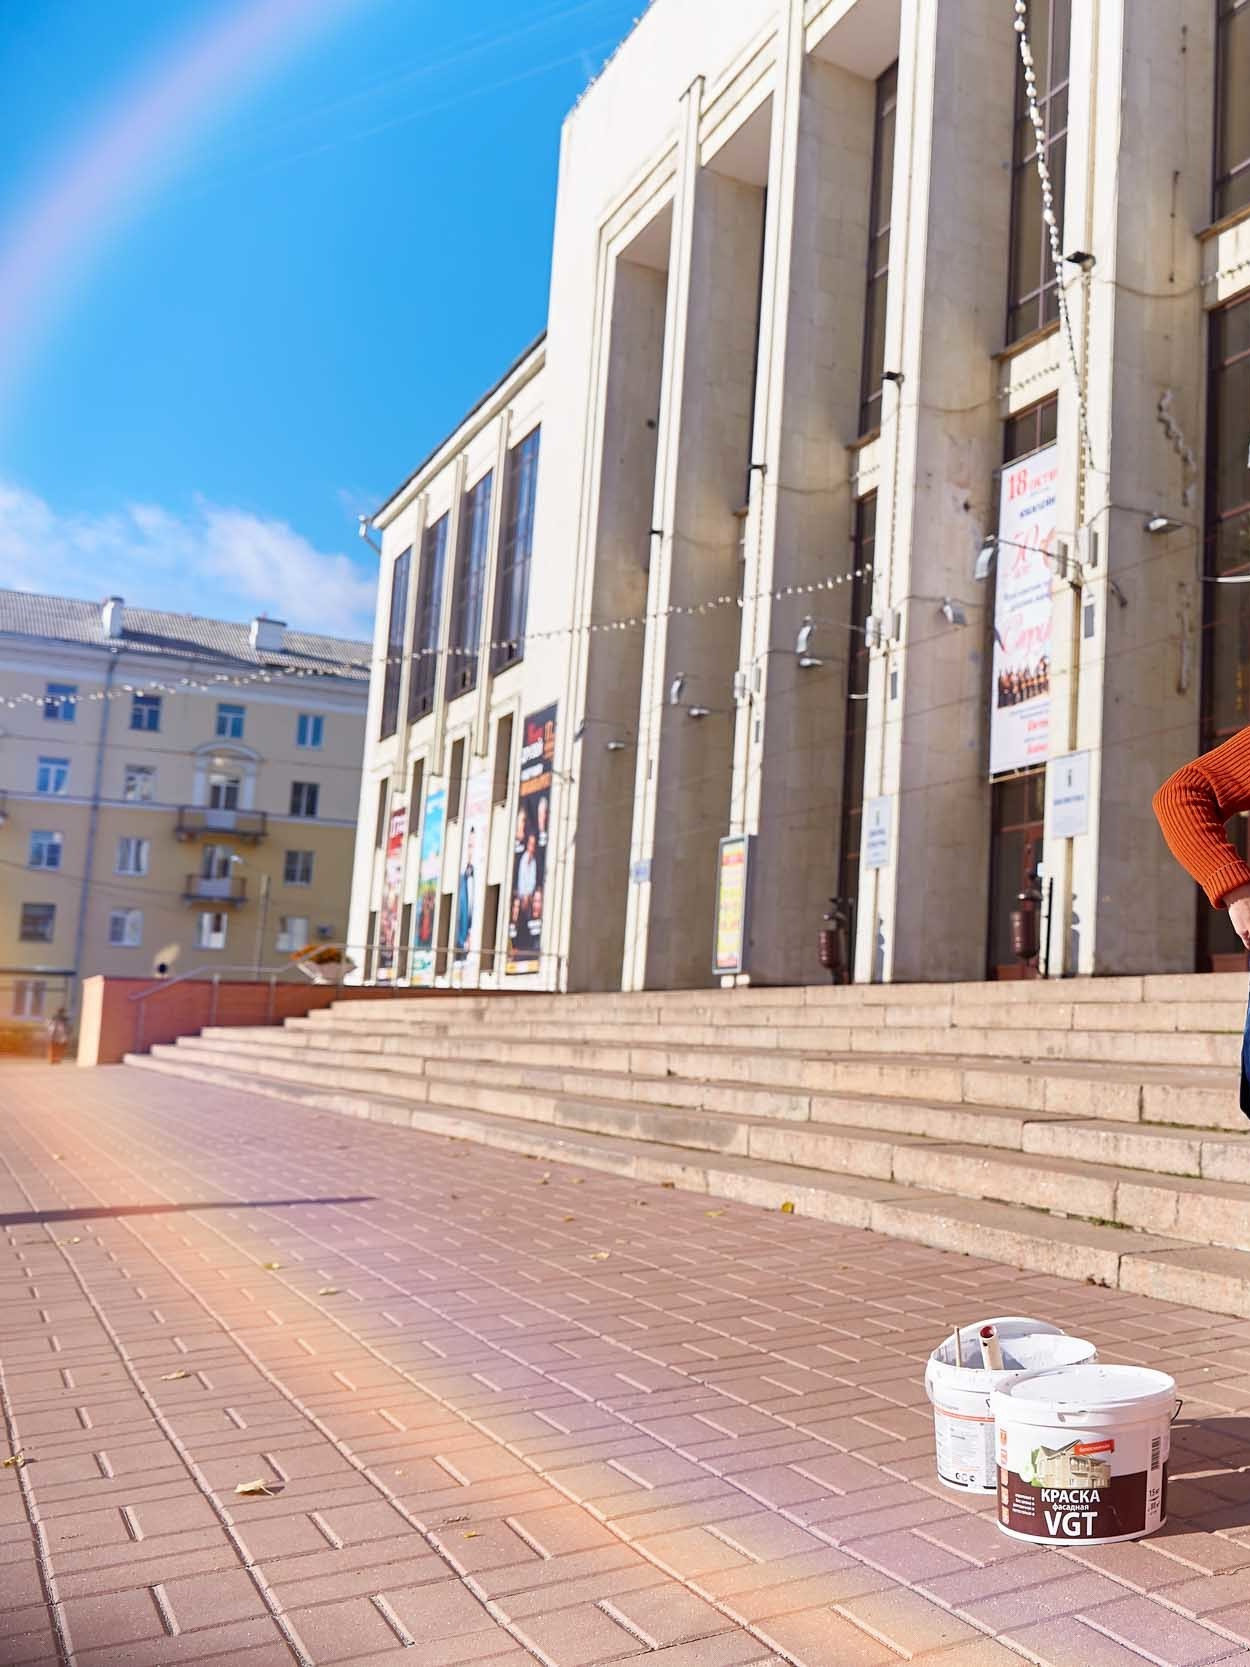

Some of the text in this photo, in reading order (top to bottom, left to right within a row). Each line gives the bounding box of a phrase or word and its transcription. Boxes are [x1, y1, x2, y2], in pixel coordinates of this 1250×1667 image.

[1007, 468, 1028, 501] 18
[1041, 1488, 1101, 1504] КРАСКА
[1052, 1503, 1089, 1511] фасадная
[1044, 1510, 1098, 1537] VGT
